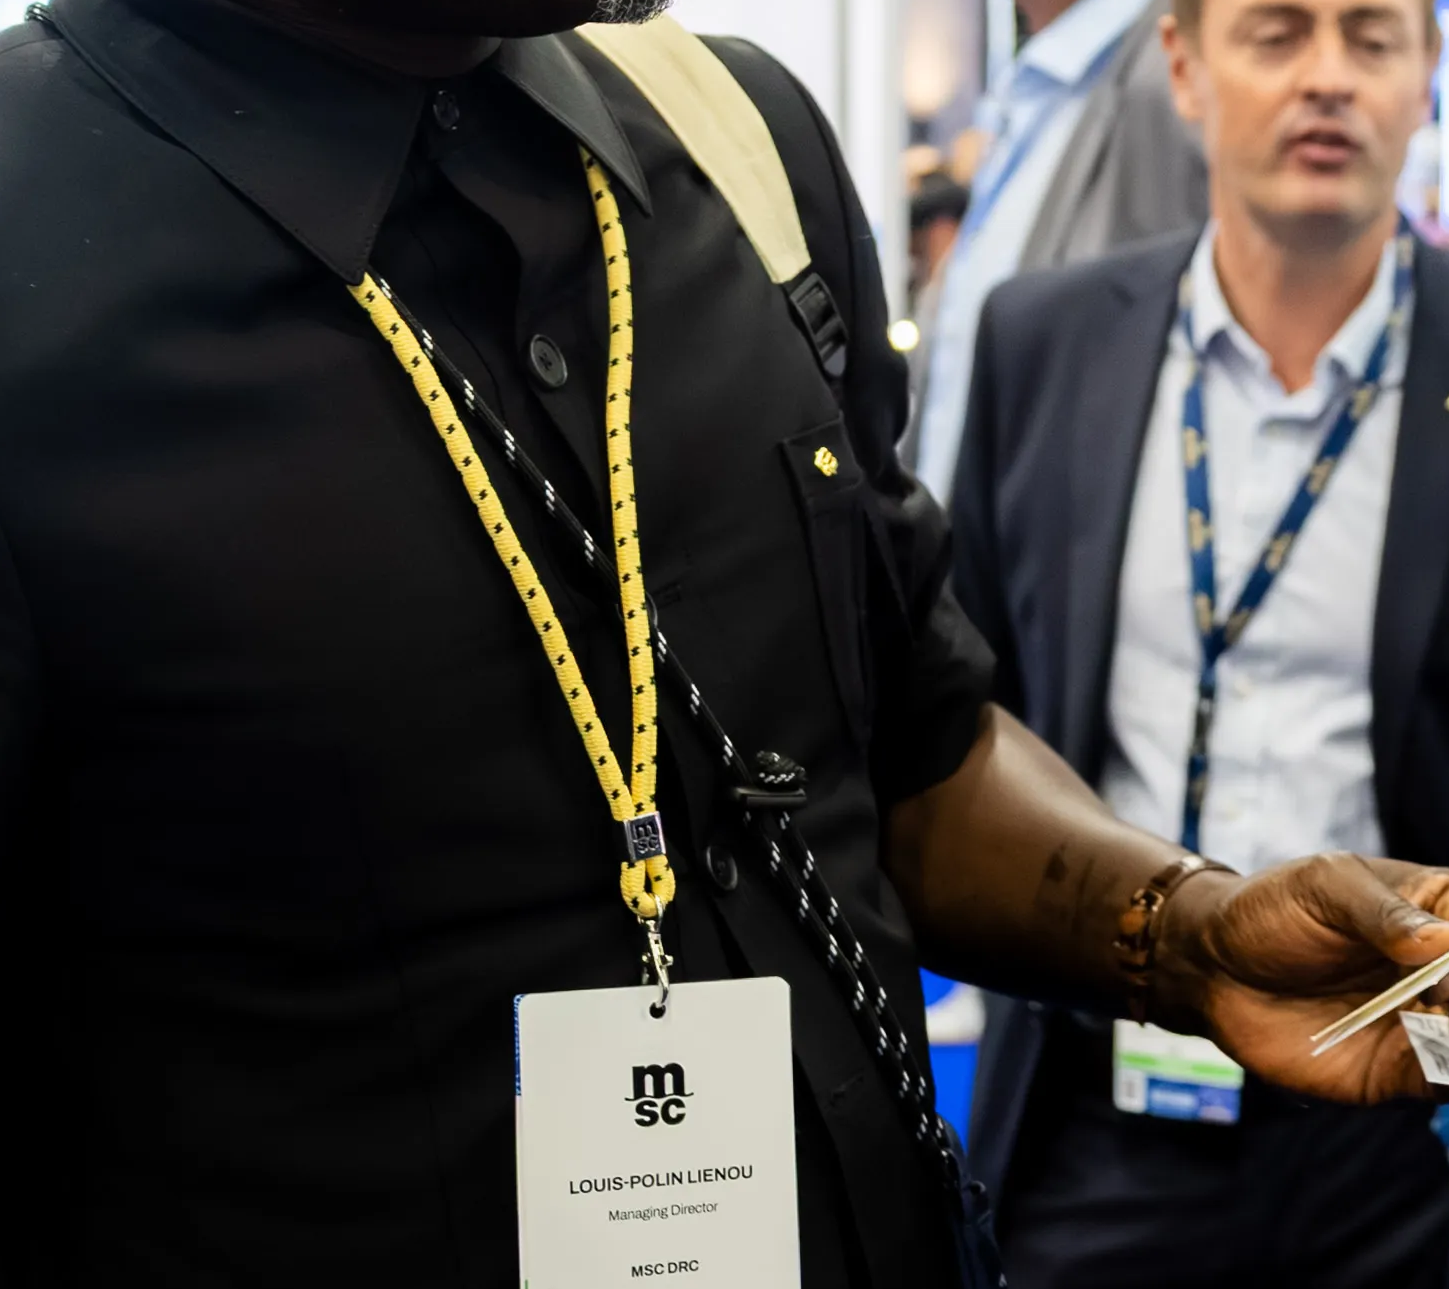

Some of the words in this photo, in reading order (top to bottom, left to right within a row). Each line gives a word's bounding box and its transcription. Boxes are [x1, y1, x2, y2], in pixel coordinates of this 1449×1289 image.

[568, 1169, 684, 1196] LOUIS-POLIN
[687, 1164, 754, 1185] LIENOU
[608, 1205, 669, 1223] Managing
[670, 1200, 719, 1216] Director
[630, 1262, 665, 1278] MSC
[666, 1259, 700, 1274] DRC
